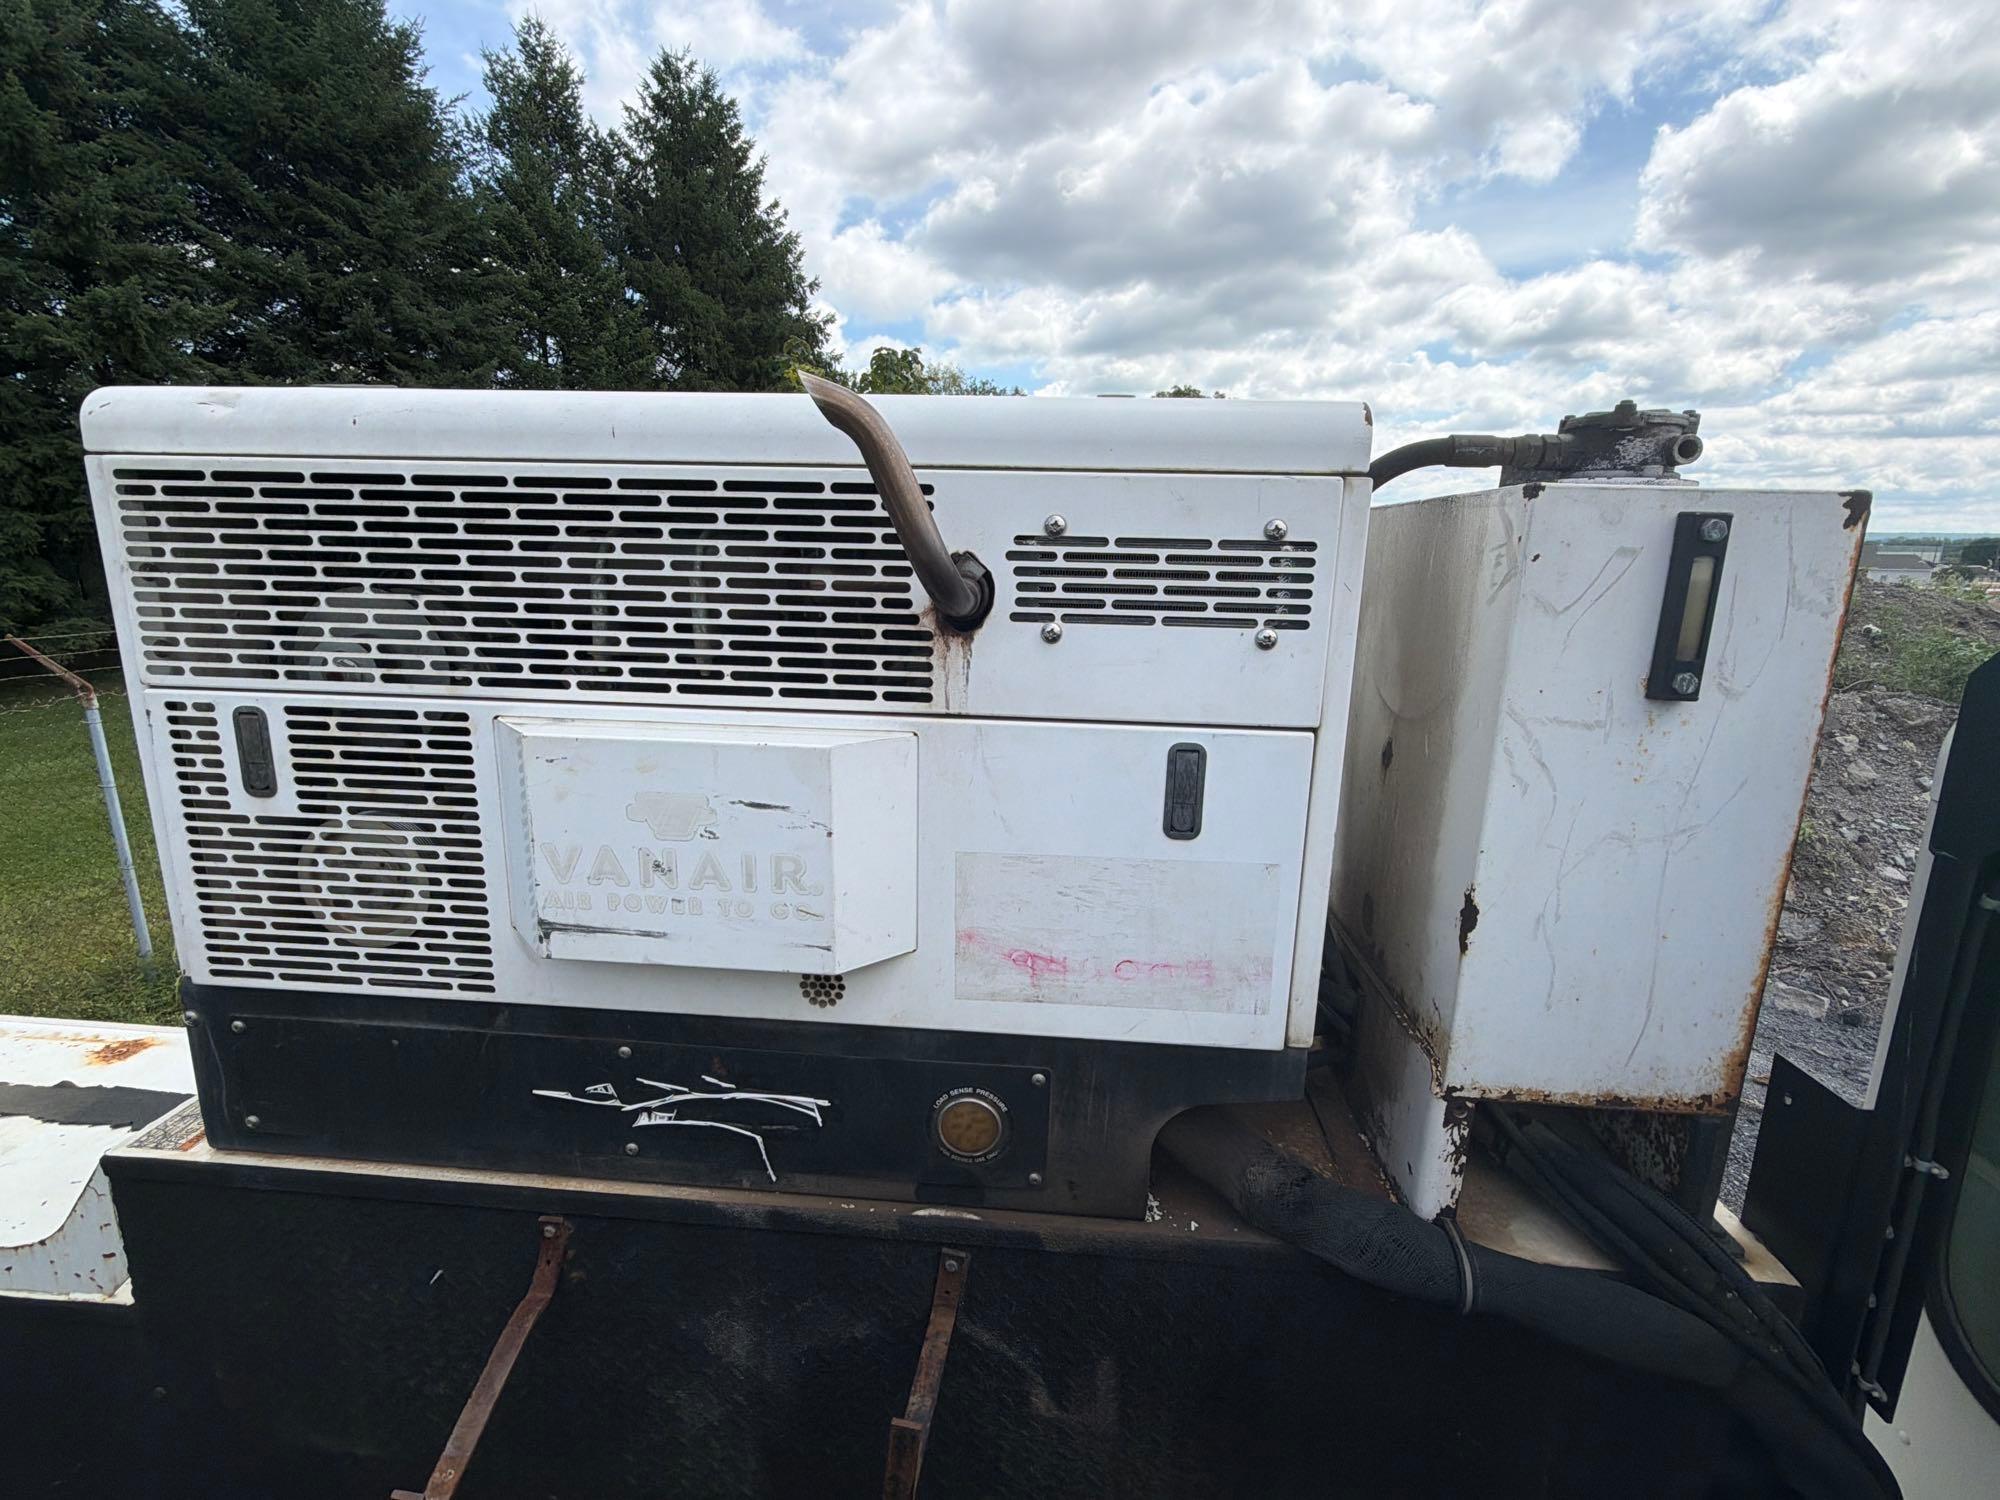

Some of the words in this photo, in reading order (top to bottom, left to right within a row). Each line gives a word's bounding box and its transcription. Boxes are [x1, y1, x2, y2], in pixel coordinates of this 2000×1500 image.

[543, 889, 593, 911] AIR
[607, 892, 703, 916] POWER
[717, 898, 754, 918] TO
[933, 1094, 949, 1109] LOAD
[950, 1087, 973, 1097] SENSE
[976, 1088, 1008, 1112] PRESSURE
